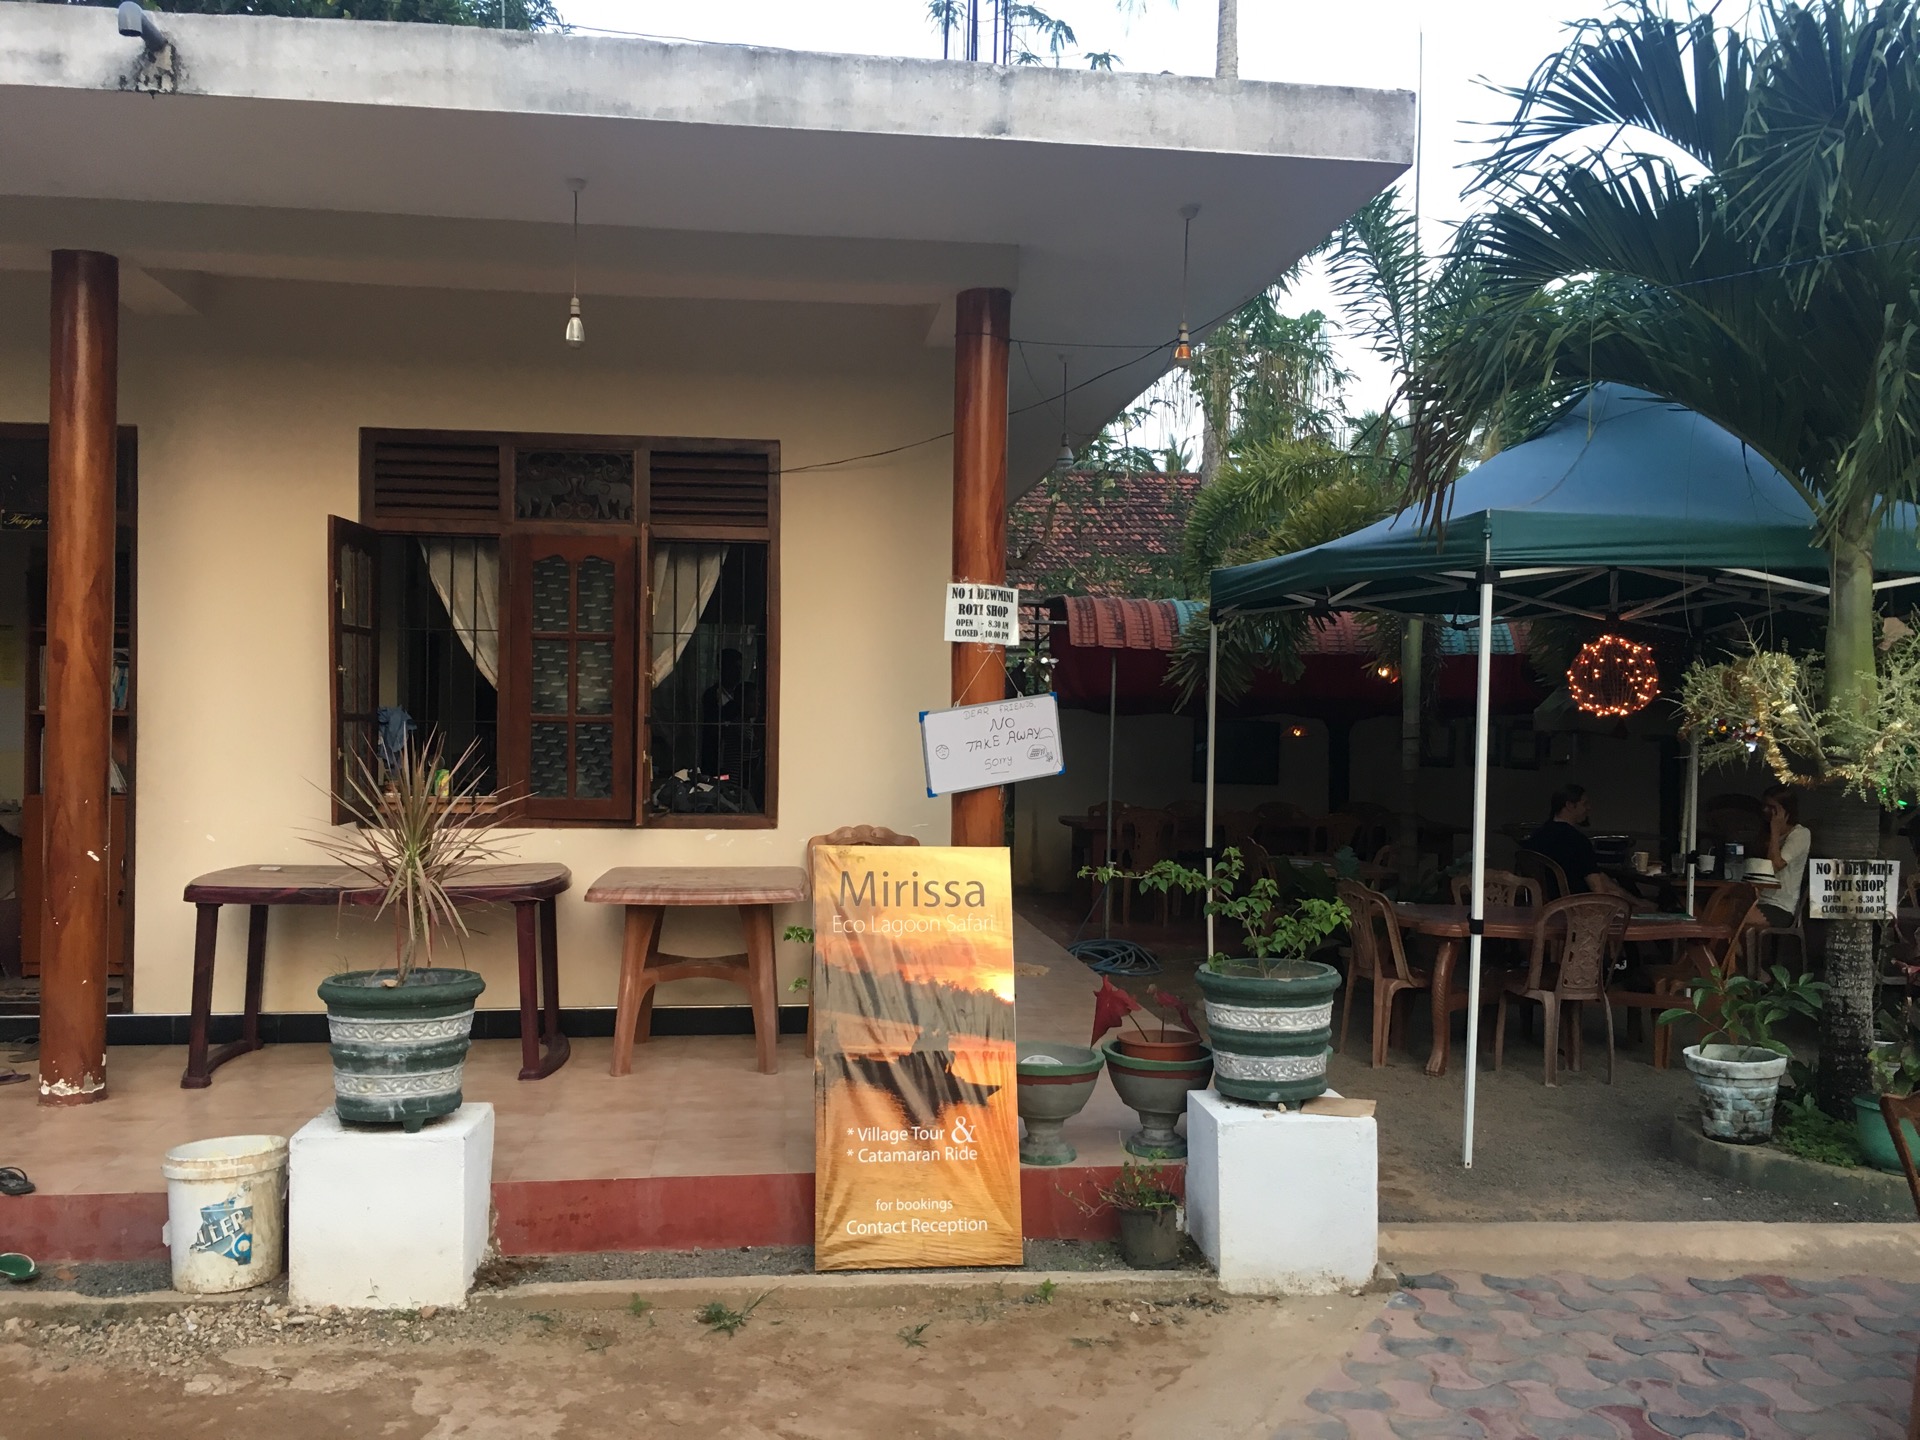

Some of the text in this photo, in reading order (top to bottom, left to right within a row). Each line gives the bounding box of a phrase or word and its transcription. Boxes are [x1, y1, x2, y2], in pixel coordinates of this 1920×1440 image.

[952, 587, 1014, 603] NO 1 DEWMINI
[958, 604, 1009, 618] ROTI SHOP
[956, 619, 973, 627] OPEN
[988, 620, 1001, 629] 8.30
[1002, 622, 1009, 630] AM
[955, 629, 978, 638] CLOSED
[985, 630, 1000, 639] 10.00
[1001, 631, 1009, 640] PM
[963, 706, 989, 720] DEAR
[990, 717, 1015, 732] NO
[966, 727, 1041, 752] TAKE AWAY
[1816, 862, 1831, 875] NO
[840, 871, 985, 908] Mirissa
[1824, 879, 1884, 892] ROTI SHOP
[1822, 895, 1841, 903] OPEN
[1858, 895, 1874, 903] 8.30
[1822, 906, 1847, 914] CLOSED
[1856, 905, 1874, 914] 10.00
[833, 912, 994, 937] Eco Lagoon Safari
[858, 1116, 977, 1144] Village Tour &
[858, 1146, 978, 1163] Catamaran Ride
[876, 1198, 953, 1212] for bookings
[846, 1218, 988, 1235] Contact Reception
